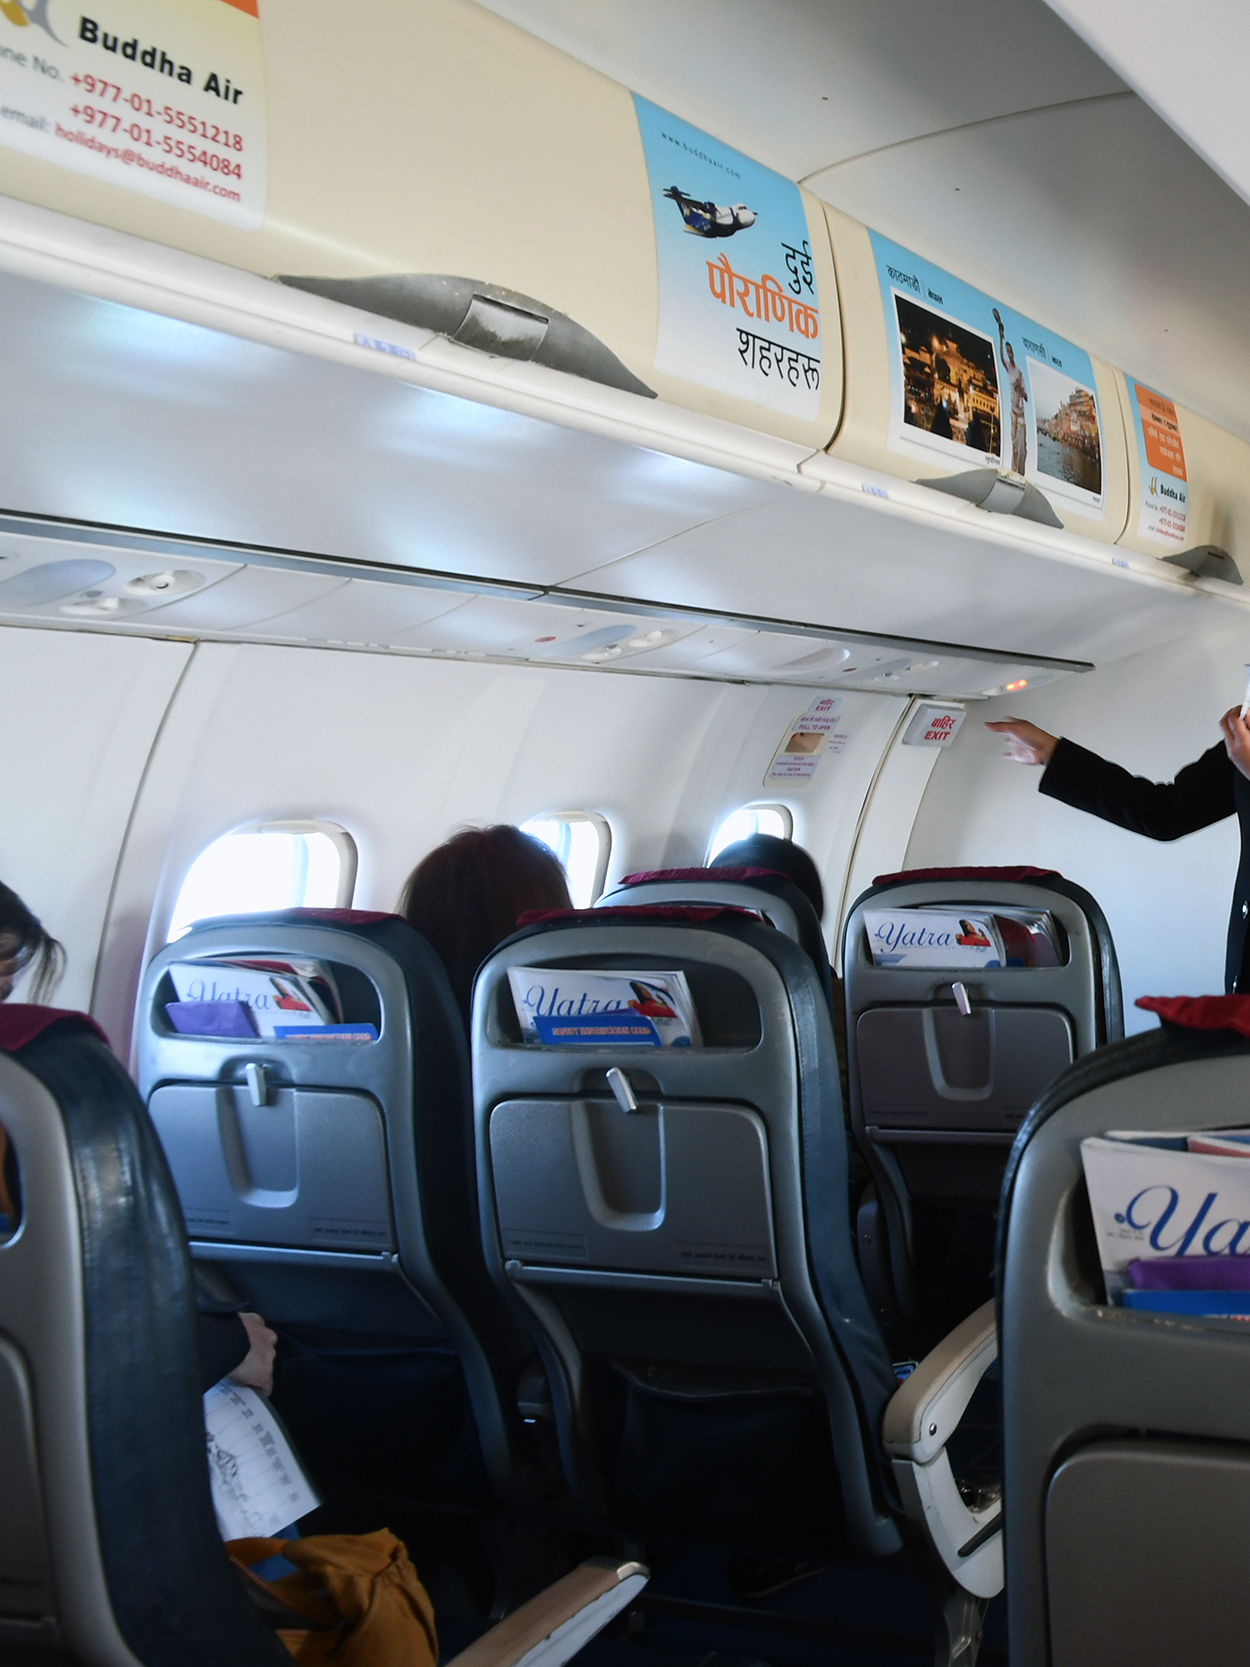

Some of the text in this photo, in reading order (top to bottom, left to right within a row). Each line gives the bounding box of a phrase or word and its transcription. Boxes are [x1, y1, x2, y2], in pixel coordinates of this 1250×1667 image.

[79, 17, 243, 104] Buddha Air
[70, 71, 243, 152] +977-01-5551218
[54, 122, 241, 202] holidays@buddhaair.com
[70, 104, 242, 180] +977-01-5554084
[661, 132, 742, 179] www.buddhaair.com
[705, 252, 818, 339] पौराणिक
[1160, 484, 1178, 500] Buddha
[924, 731, 951, 740] EXIT
[931, 715, 957, 729] बाहिर
[875, 921, 953, 953] Yatra
[187, 979, 272, 1010] Yatra
[523, 985, 623, 1018] Yatra
